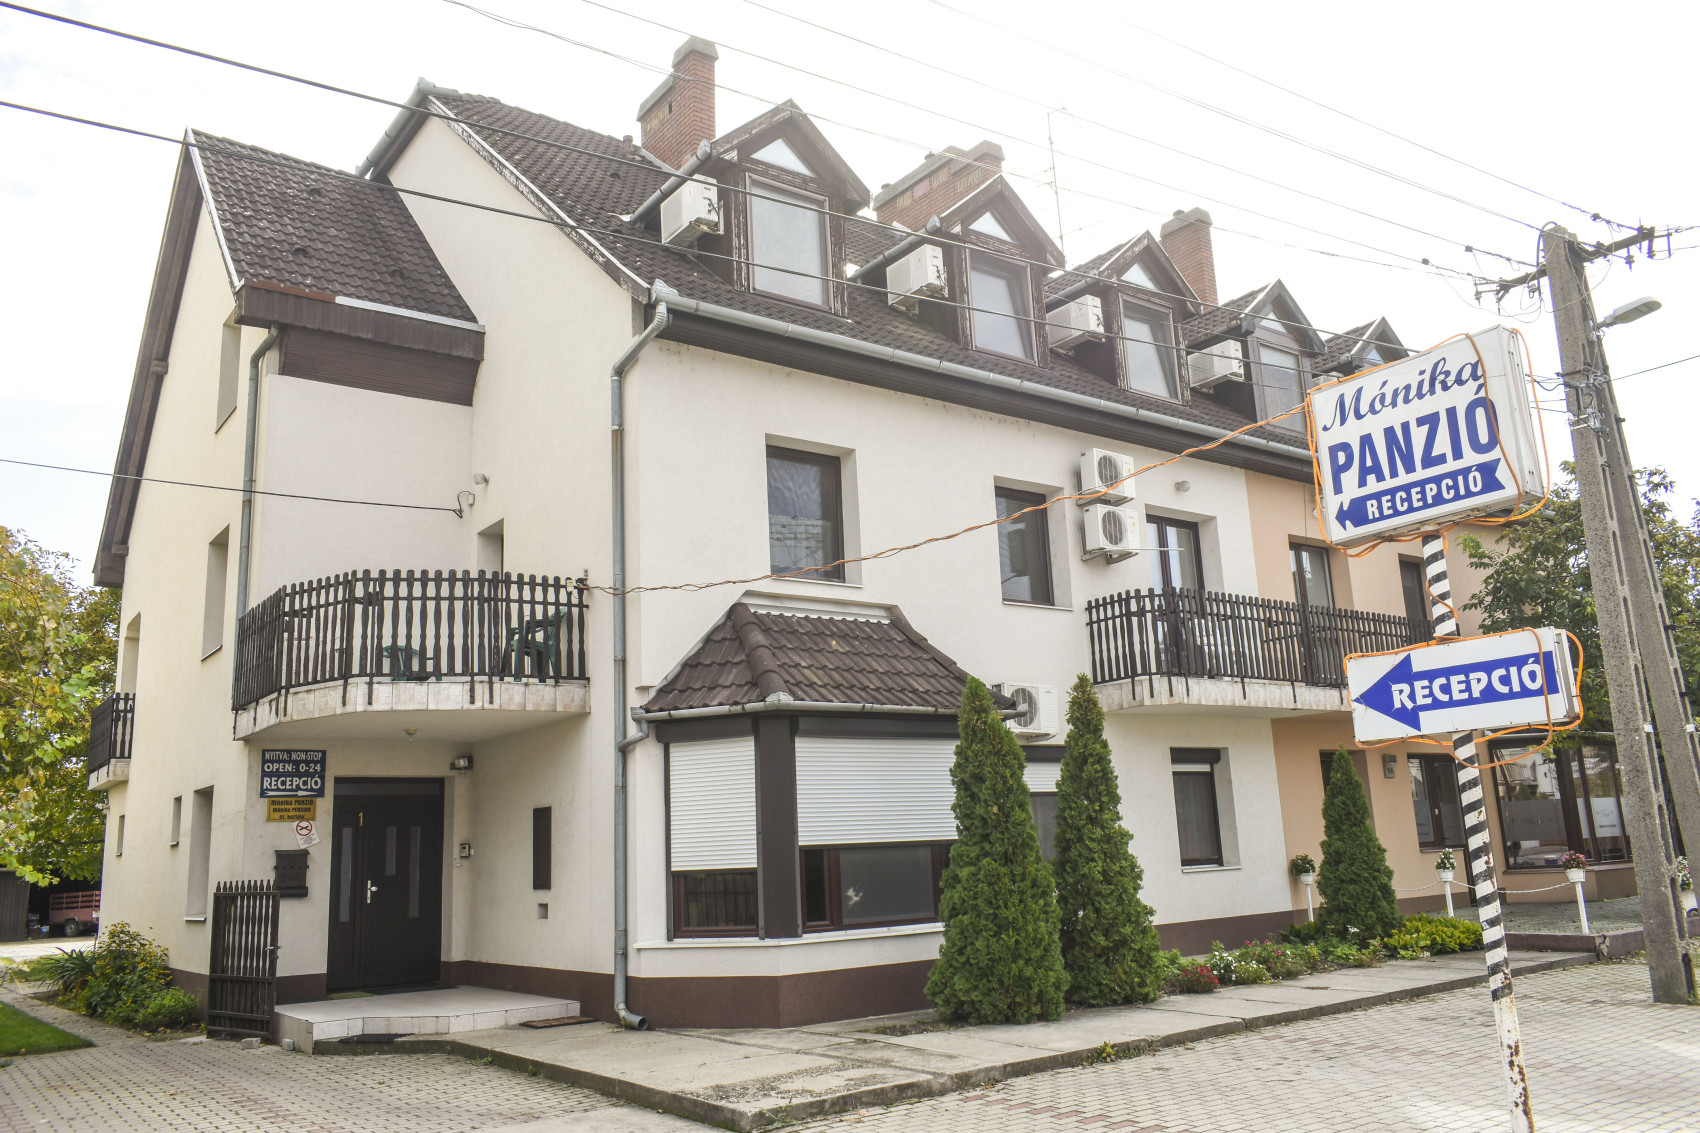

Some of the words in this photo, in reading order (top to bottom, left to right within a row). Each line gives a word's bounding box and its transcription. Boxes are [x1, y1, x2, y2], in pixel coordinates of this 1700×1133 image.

[1322, 357, 1487, 432] Mónika
[1327, 383, 1500, 496] PANZIÓ
[1366, 466, 1483, 520] RECEPCIÓ
[1390, 658, 1543, 711] RECEPCIÓ
[263, 775, 321, 789] RECEPCIÓ
[264, 763, 296, 772] OPEN:
[299, 763, 321, 772] 0-24
[265, 751, 290, 760] NYITVA:
[291, 752, 322, 761] NON-STOP
